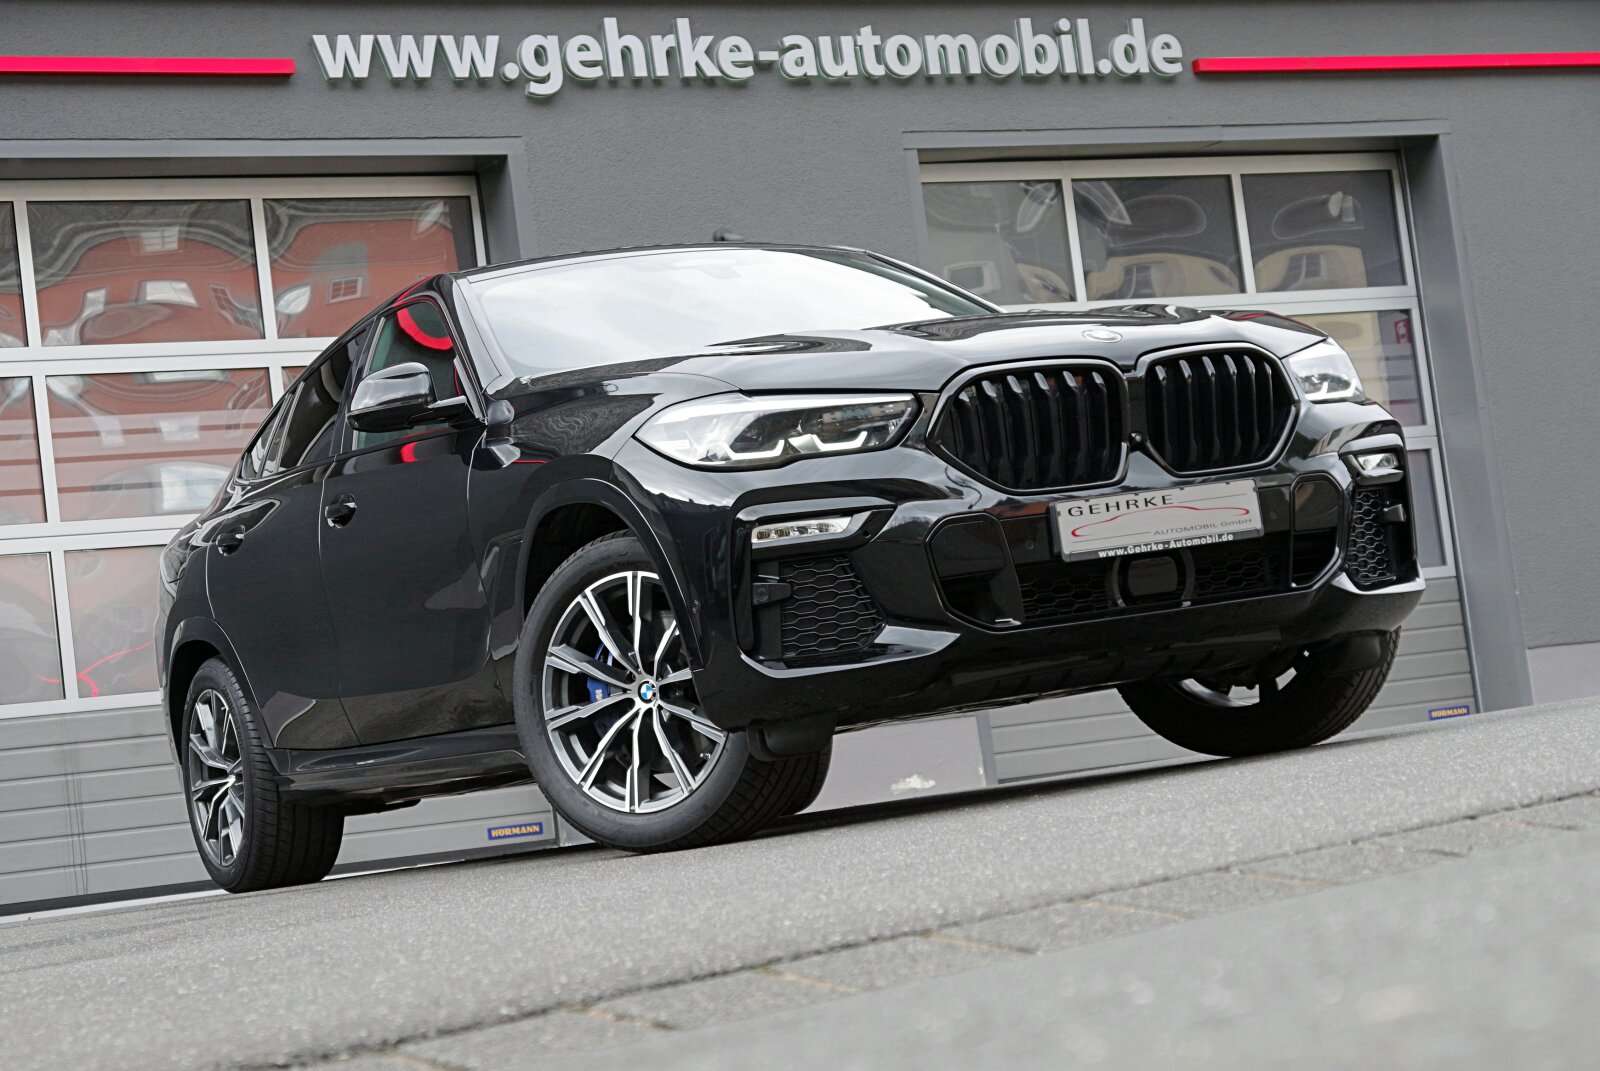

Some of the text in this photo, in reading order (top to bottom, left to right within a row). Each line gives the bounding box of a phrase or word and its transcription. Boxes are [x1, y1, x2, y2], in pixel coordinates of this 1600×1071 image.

[312, 17, 1183, 98] www.gehrke-automobil.de
[1067, 494, 1174, 517] GEHRKE
[1153, 518, 1252, 535] AUTOMOBIL GmbH
[1098, 533, 1234, 558] www.Gehrke-Automobil.de
